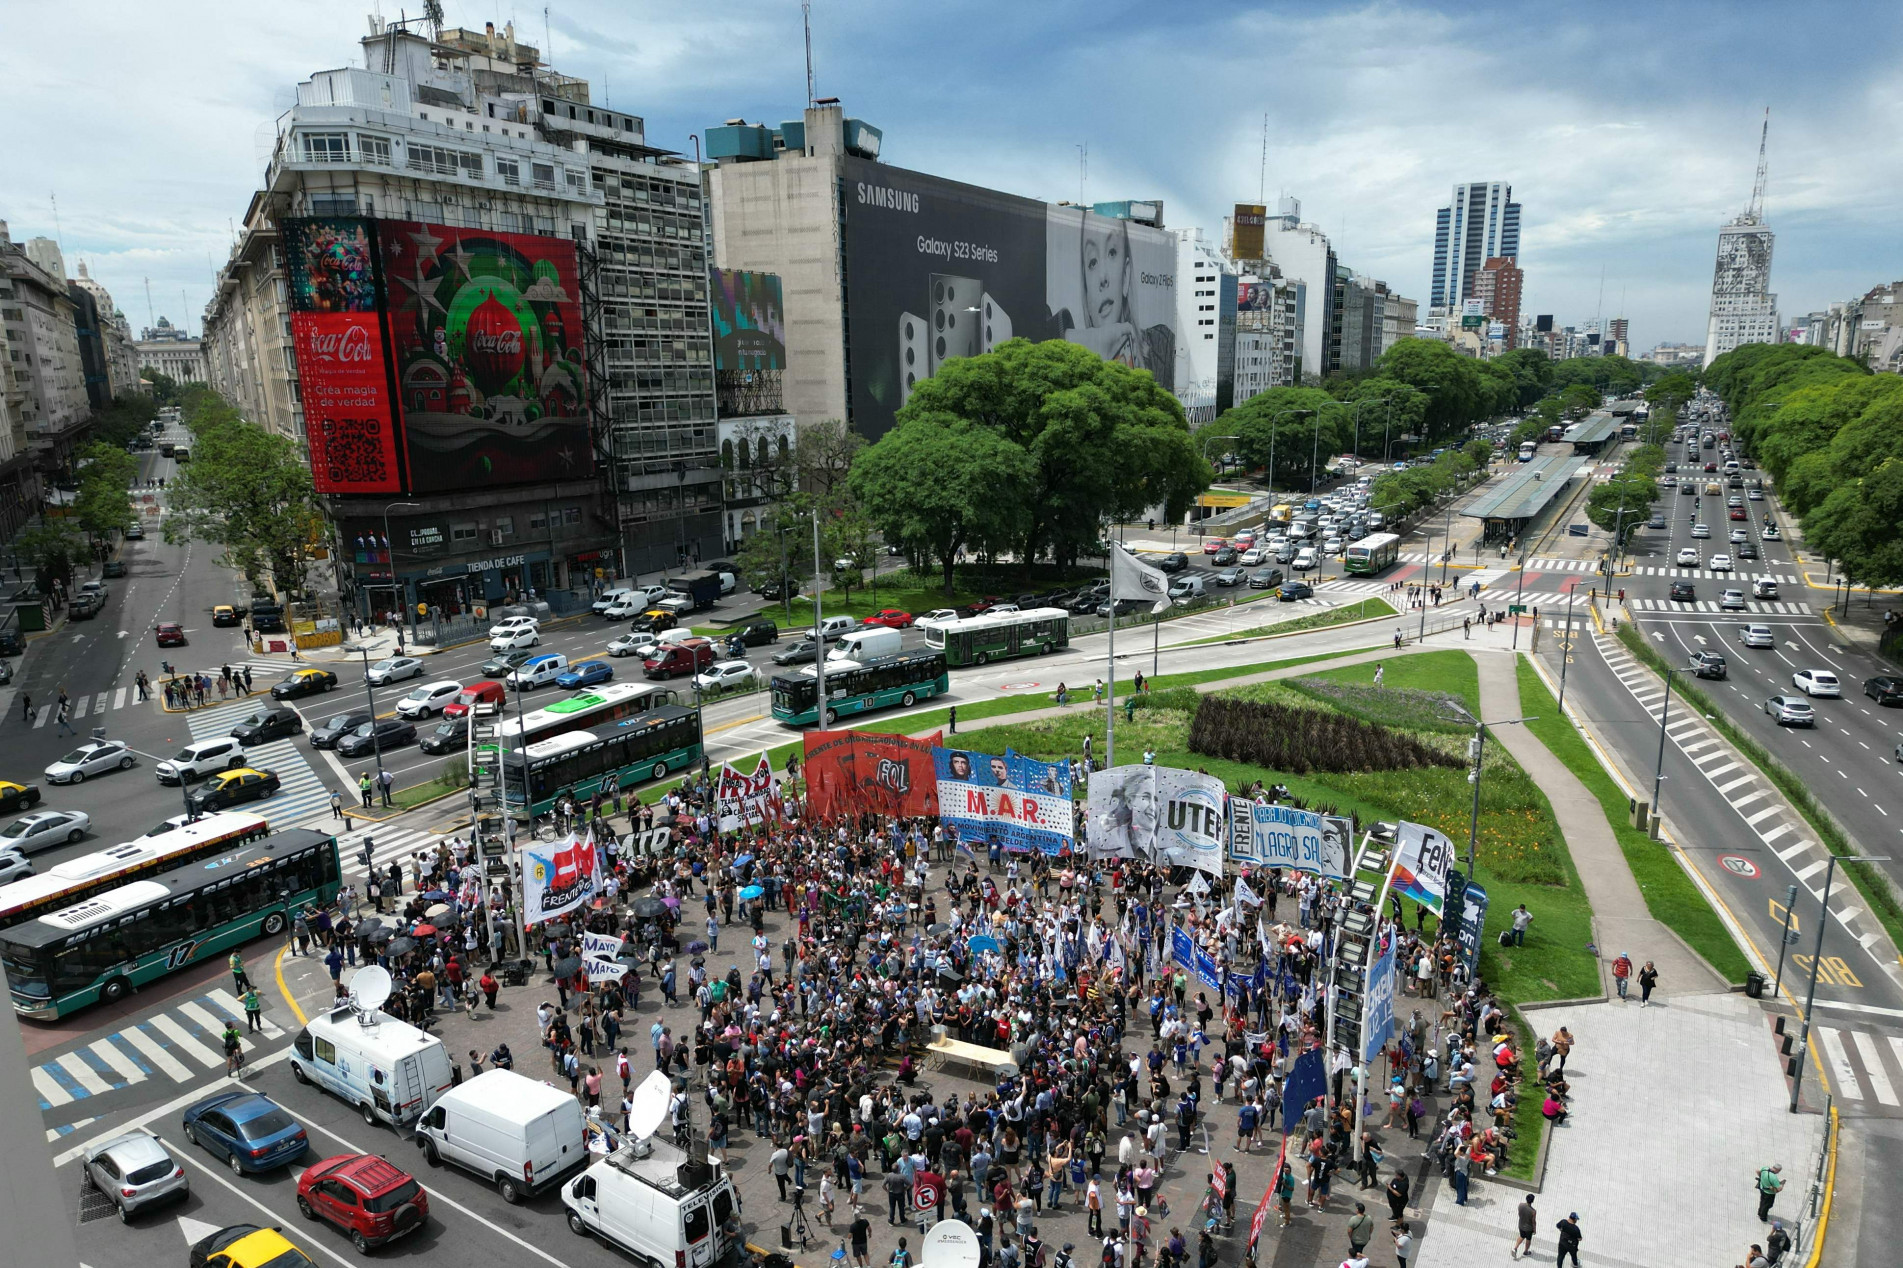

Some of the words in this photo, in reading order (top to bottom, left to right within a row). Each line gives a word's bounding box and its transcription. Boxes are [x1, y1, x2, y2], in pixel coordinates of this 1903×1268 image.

[857, 182, 919, 214] SAMSUNG
[917, 235, 952, 261] Galaxy
[954, 241, 969, 258] S23
[971, 244, 998, 262] Series
[1141, 271, 1158, 288] Galaxy
[1159, 274, 1163, 286] Z
[344, 384, 377, 397] magia
[320, 398, 334, 407] de
[337, 397, 376, 407] verdad
[466, 560, 494, 573] TIENDA
[494, 558, 505, 568] DE
[506, 555, 525, 567] CAFE
[862, 697, 875, 708] 10
[532, 750, 579, 771] WILDE
[608, 717, 686, 746] RECOLETA
[805, 743, 833, 760] FRENTE
[833, 739, 844, 747] DE
[920, 745, 932, 754] LU
[877, 758, 908, 793] FOL
[733, 804, 756, 816] CABIO
[966, 789, 1046, 825] M.A.R.
[957, 823, 1009, 836] MOVIMIENTO
[1010, 830, 1059, 844] ARGENTINA
[1233, 798, 1251, 855] FRENTE
[996, 835, 1025, 847] EBELDE
[1724, 859, 1754, 873] 20
[65, 908, 151, 948] WILDE
[158, 892, 195, 911] 17
[202, 847, 316, 897] RECOLETA
[543, 886, 580, 909] FRENTE
[166, 939, 197, 970] 17
[1791, 953, 1865, 988] BUS
[682, 1179, 728, 1212] TELEVISION
[920, 1189, 932, 1206] E
